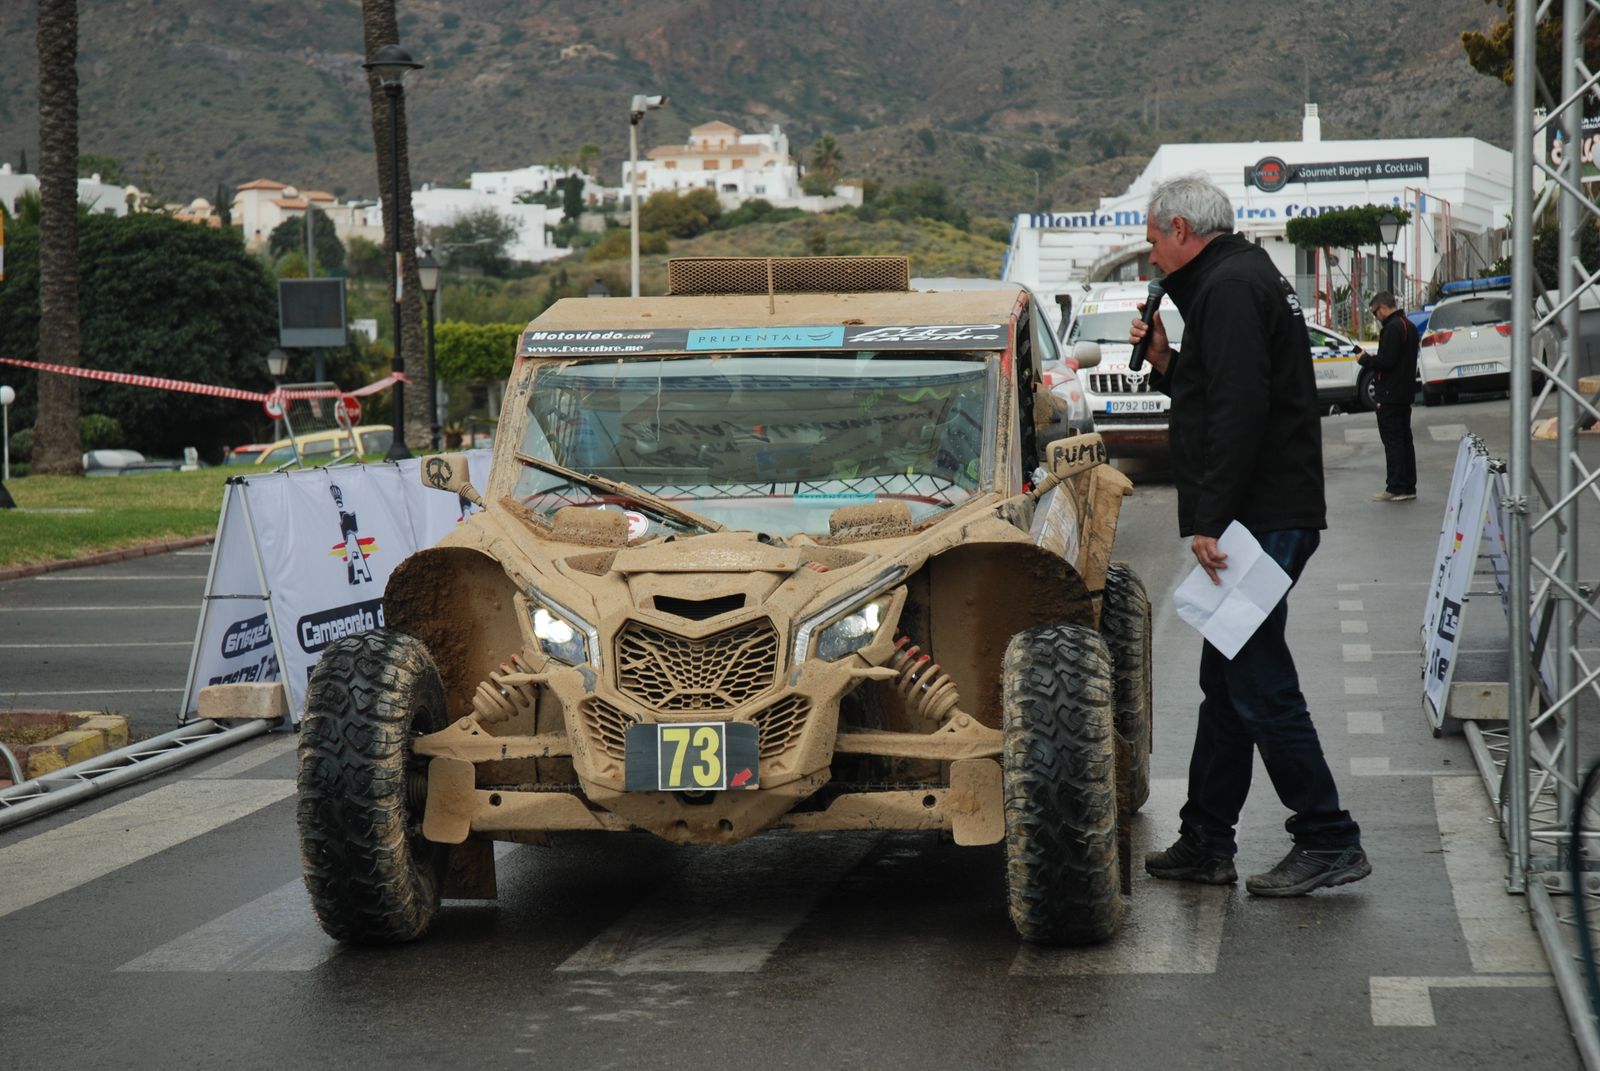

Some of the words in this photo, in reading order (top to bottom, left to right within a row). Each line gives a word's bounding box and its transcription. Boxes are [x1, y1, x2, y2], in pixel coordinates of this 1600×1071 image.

[1299, 166, 1337, 178] Gourmet
[1338, 165, 1372, 178] Burgers
[1375, 163, 1383, 174] &
[1385, 163, 1423, 174] Cocktails
[531, 331, 653, 340] Motoviedo.com
[698, 334, 802, 344] PRIDENTAL
[527, 345, 644, 353] www.Descubre.me
[1112, 402, 1138, 411] 0792
[663, 727, 721, 787] 73
